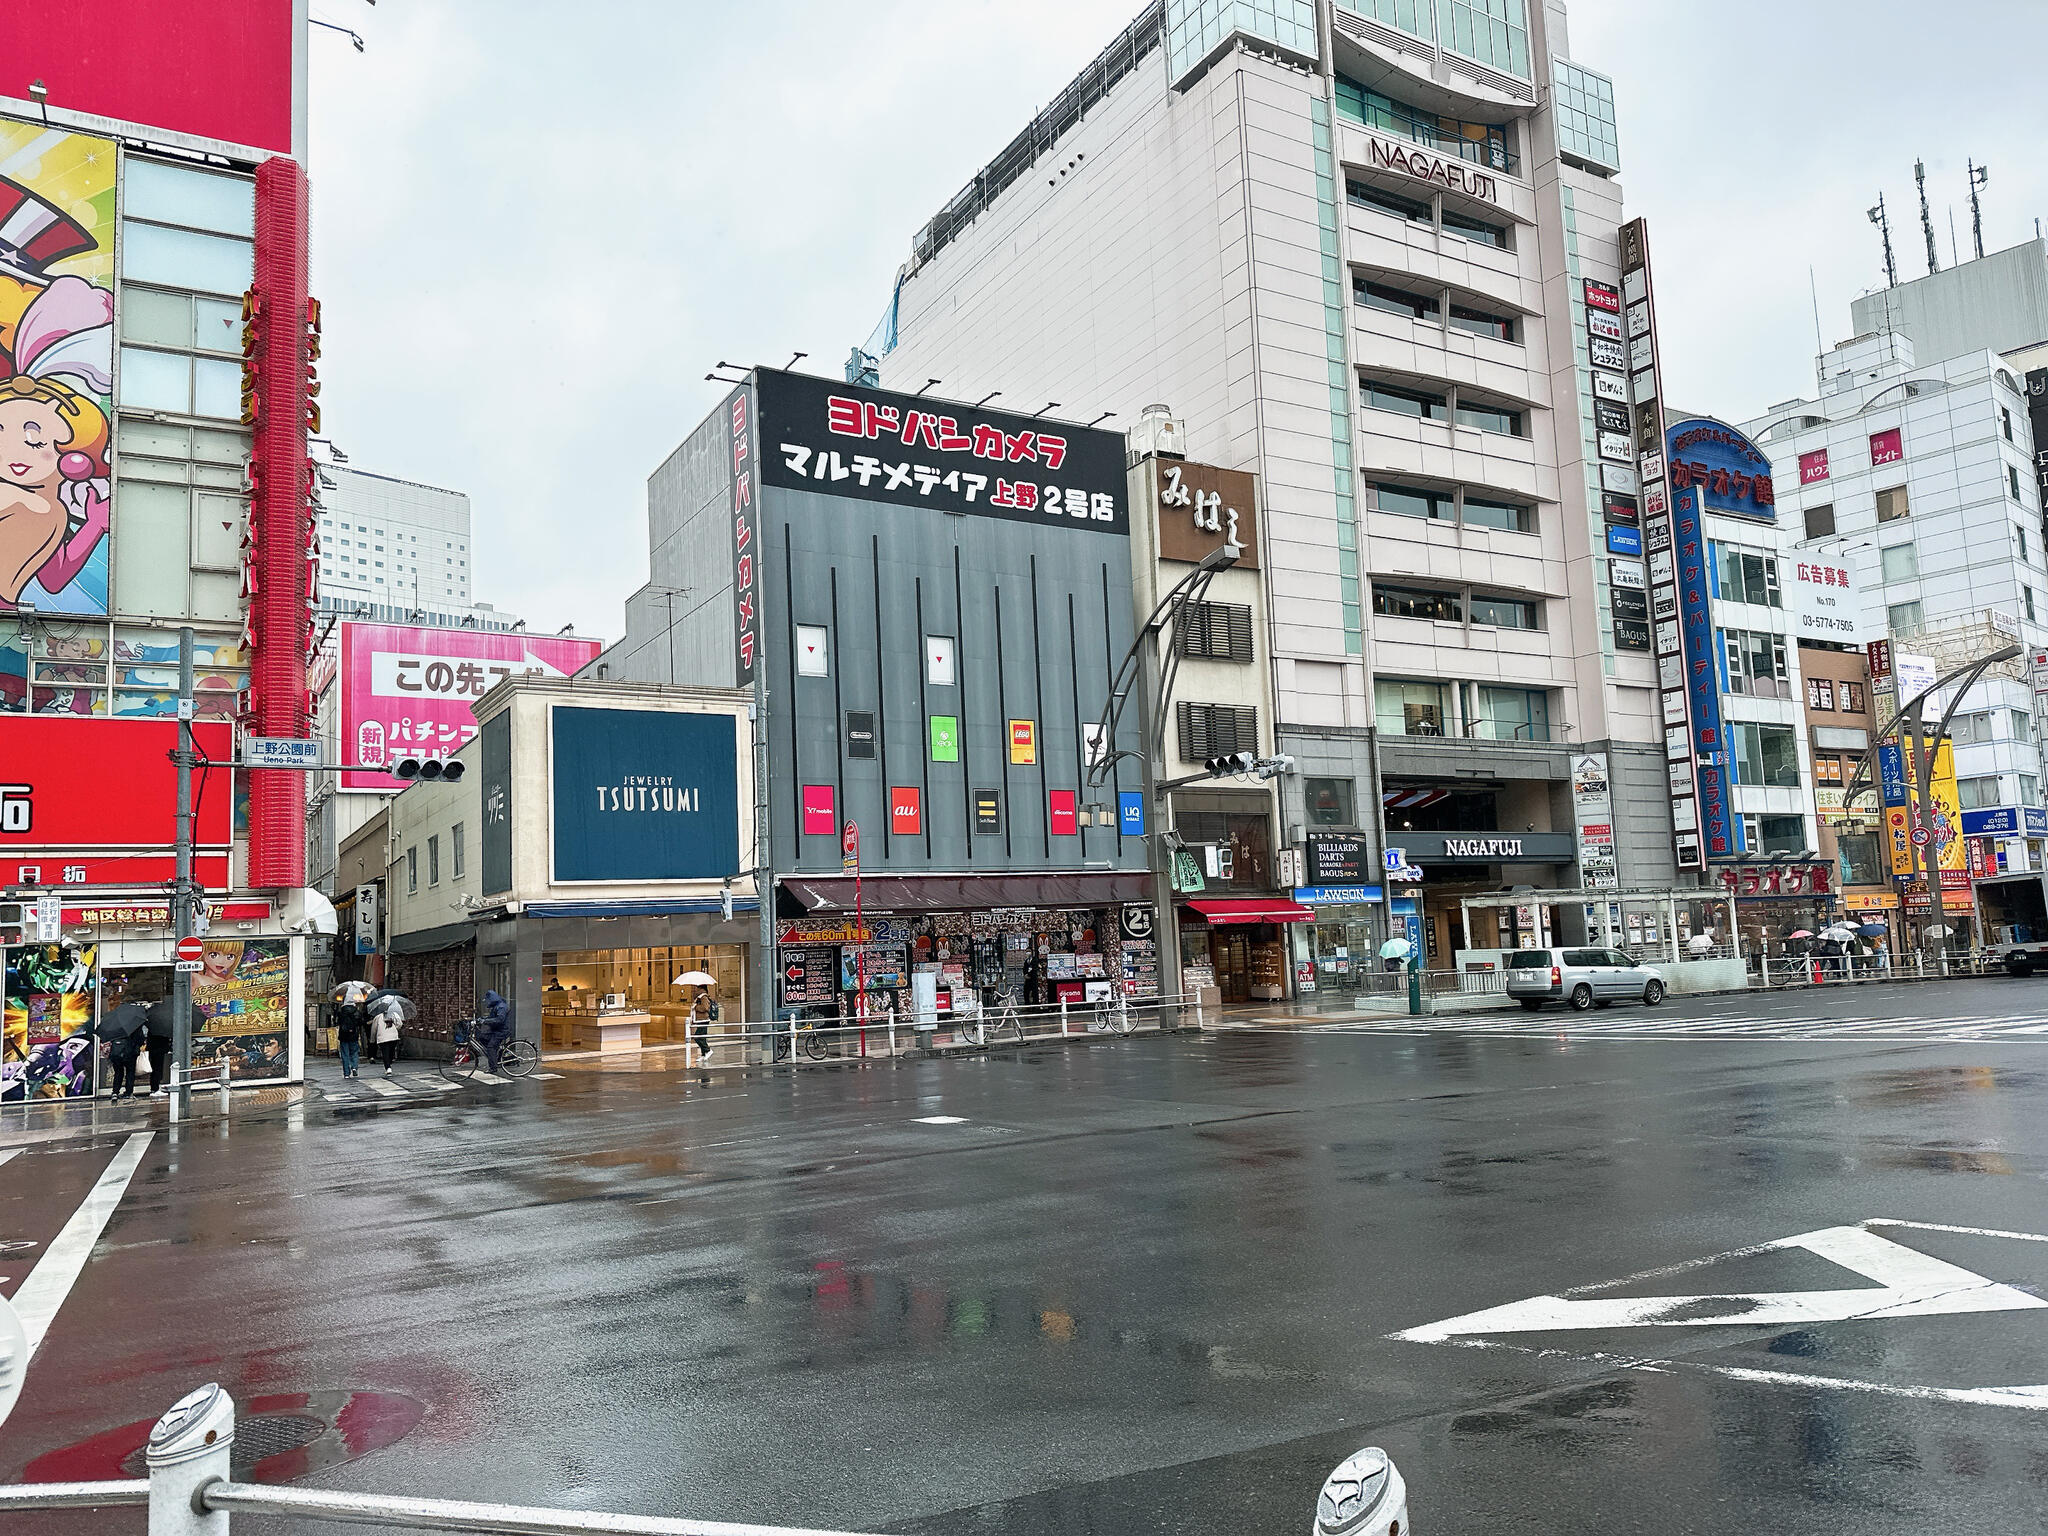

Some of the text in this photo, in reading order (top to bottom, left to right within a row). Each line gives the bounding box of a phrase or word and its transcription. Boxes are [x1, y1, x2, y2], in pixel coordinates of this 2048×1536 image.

[1370, 137, 1497, 203] NAGAFUJI
[827, 395, 1068, 470] ヨドバシカメラ
[1670, 458, 1775, 506] カラオケ館
[1161, 466, 1249, 548] みはし
[733, 393, 755, 669] ヨドバシカメラ
[1797, 562, 1850, 589] 広告募集
[1802, 614, 1854, 632] 03-5774-7505
[1620, 629, 1647, 642] BAGUS
[1015, 731, 1030, 739] LEGO
[251, 742, 317, 757] 上野公園前
[361, 726, 383, 764] 新規
[263, 756, 304, 765] Ueno Park
[623, 776, 673, 786] JEWELRY
[597, 786, 699, 812] TSUTSUMI
[894, 805, 918, 817] au
[1125, 806, 1140, 817] UQ
[1704, 768, 1727, 853] カラオケ館
[1893, 828, 1906, 852] 松屋
[1230, 832, 1261, 873] みはし
[1317, 843, 1359, 852] BILLIARDS
[1445, 839, 1523, 856] NAGAFUJI
[1319, 853, 1345, 861] DARTS
[1320, 869, 1344, 878] BAGUS
[1315, 888, 1365, 901] LAWSON
[971, 913, 1032, 926] ヨドバシカメラ
[1298, 973, 1314, 982] ATM
[786, 991, 807, 1001] 60m
[1059, 989, 1081, 998] docomo
